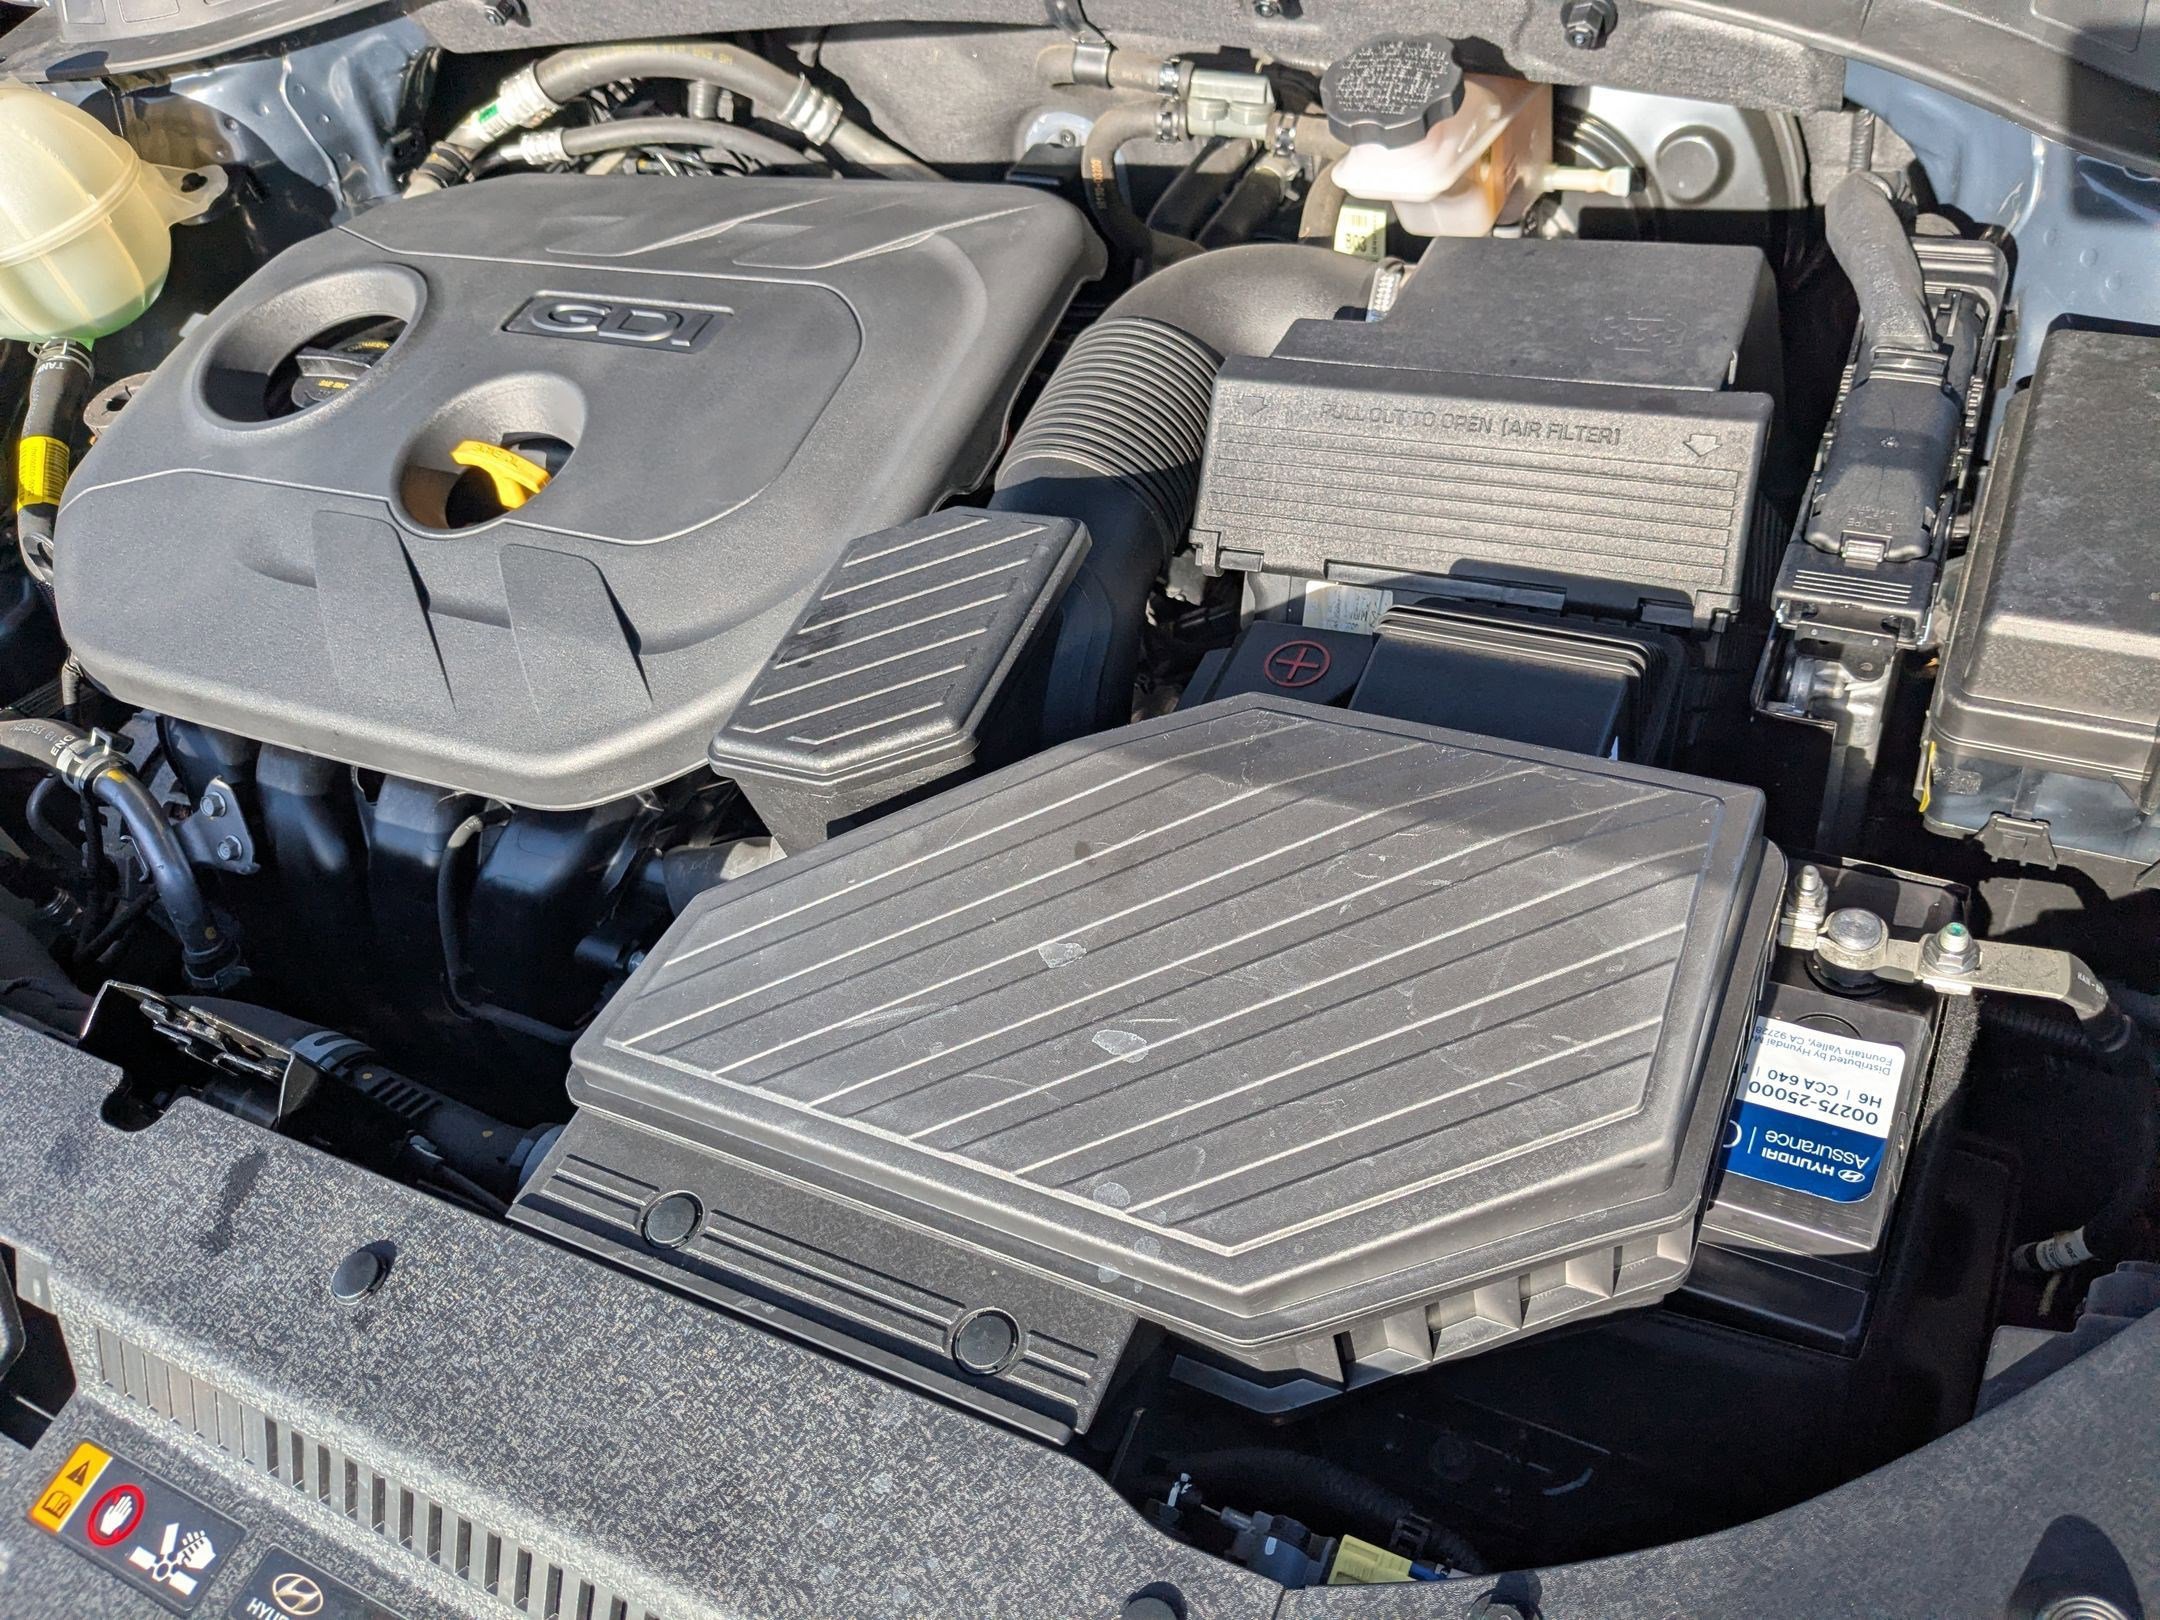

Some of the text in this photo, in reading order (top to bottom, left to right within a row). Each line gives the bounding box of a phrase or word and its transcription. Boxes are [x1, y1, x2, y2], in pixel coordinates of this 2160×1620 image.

[529, 301, 714, 347] GDI
[1320, 403, 1364, 422] PULL
[1370, 407, 1408, 426] OUT
[1411, 410, 1436, 427] TO
[1441, 412, 1493, 434] OPEN
[1751, 1033, 1891, 1076] Distributed by Hyundai M
[1755, 1026, 1893, 1067] Fountain Valley, CA 92728
[1767, 1069, 1800, 1086] 640
[1804, 1078, 1839, 1097] CCA
[1748, 1080, 1879, 1125] 00275-25000
[1858, 1092, 1882, 1109] H6
[1761, 1147, 1835, 1176] HYUNDAI
[1765, 1129, 1870, 1170] Assurance
